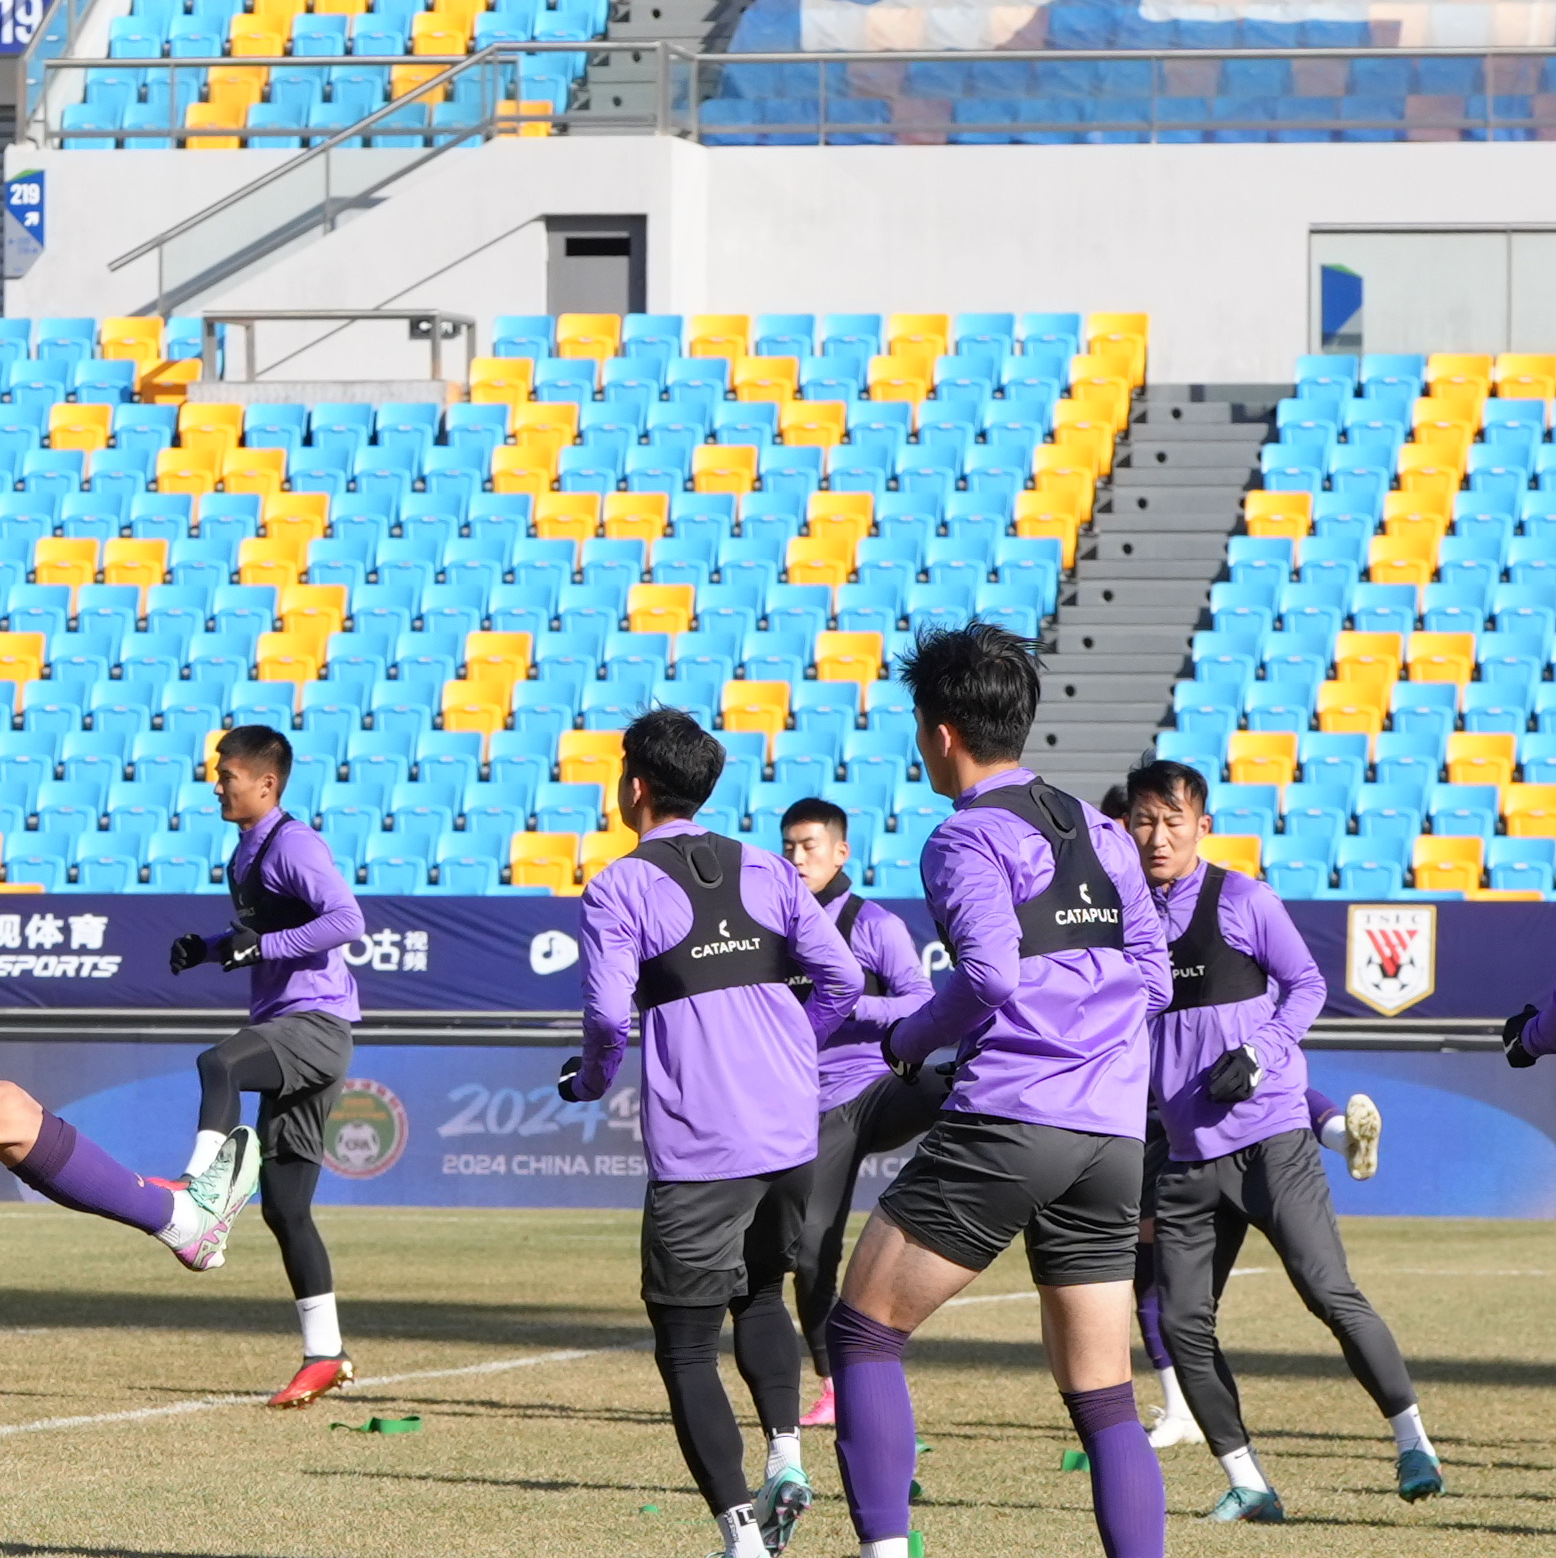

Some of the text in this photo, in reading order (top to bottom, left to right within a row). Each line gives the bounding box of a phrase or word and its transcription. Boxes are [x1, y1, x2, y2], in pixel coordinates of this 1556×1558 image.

[9, 182, 41, 206] 219
[1054, 907, 1119, 926] CATAPULT
[690, 937, 761, 959] CATAPULT
[1172, 964, 1206, 980] PULT
[437, 1082, 608, 1144] 2024
[442, 1153, 507, 1175] 2024
[511, 1153, 591, 1176] CHINA
